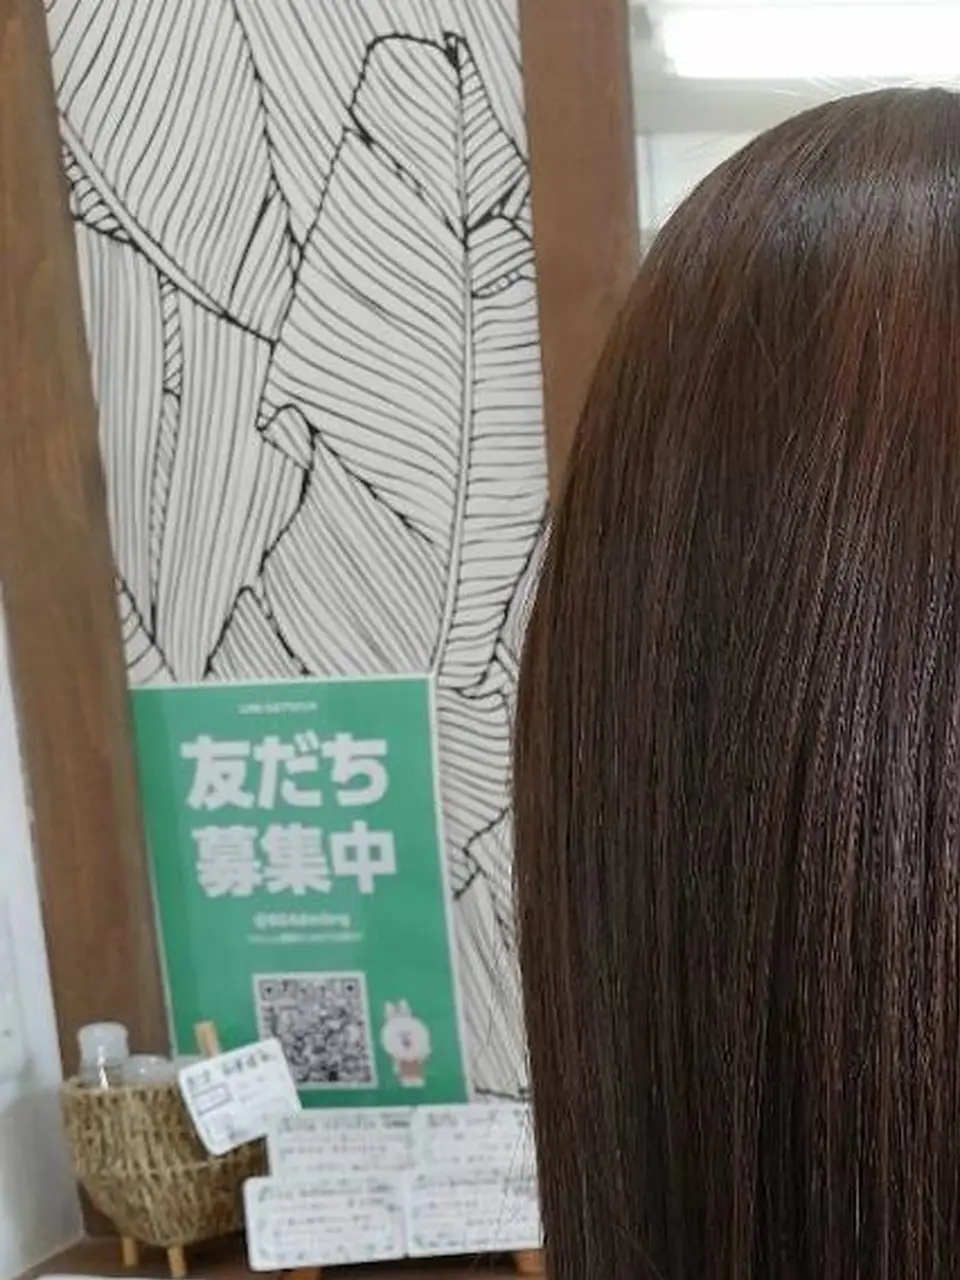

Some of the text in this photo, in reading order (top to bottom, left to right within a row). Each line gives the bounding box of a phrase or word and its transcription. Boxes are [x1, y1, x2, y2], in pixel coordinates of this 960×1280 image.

[180, 729, 388, 810] 友だち
[191, 819, 397, 897] 募集中
